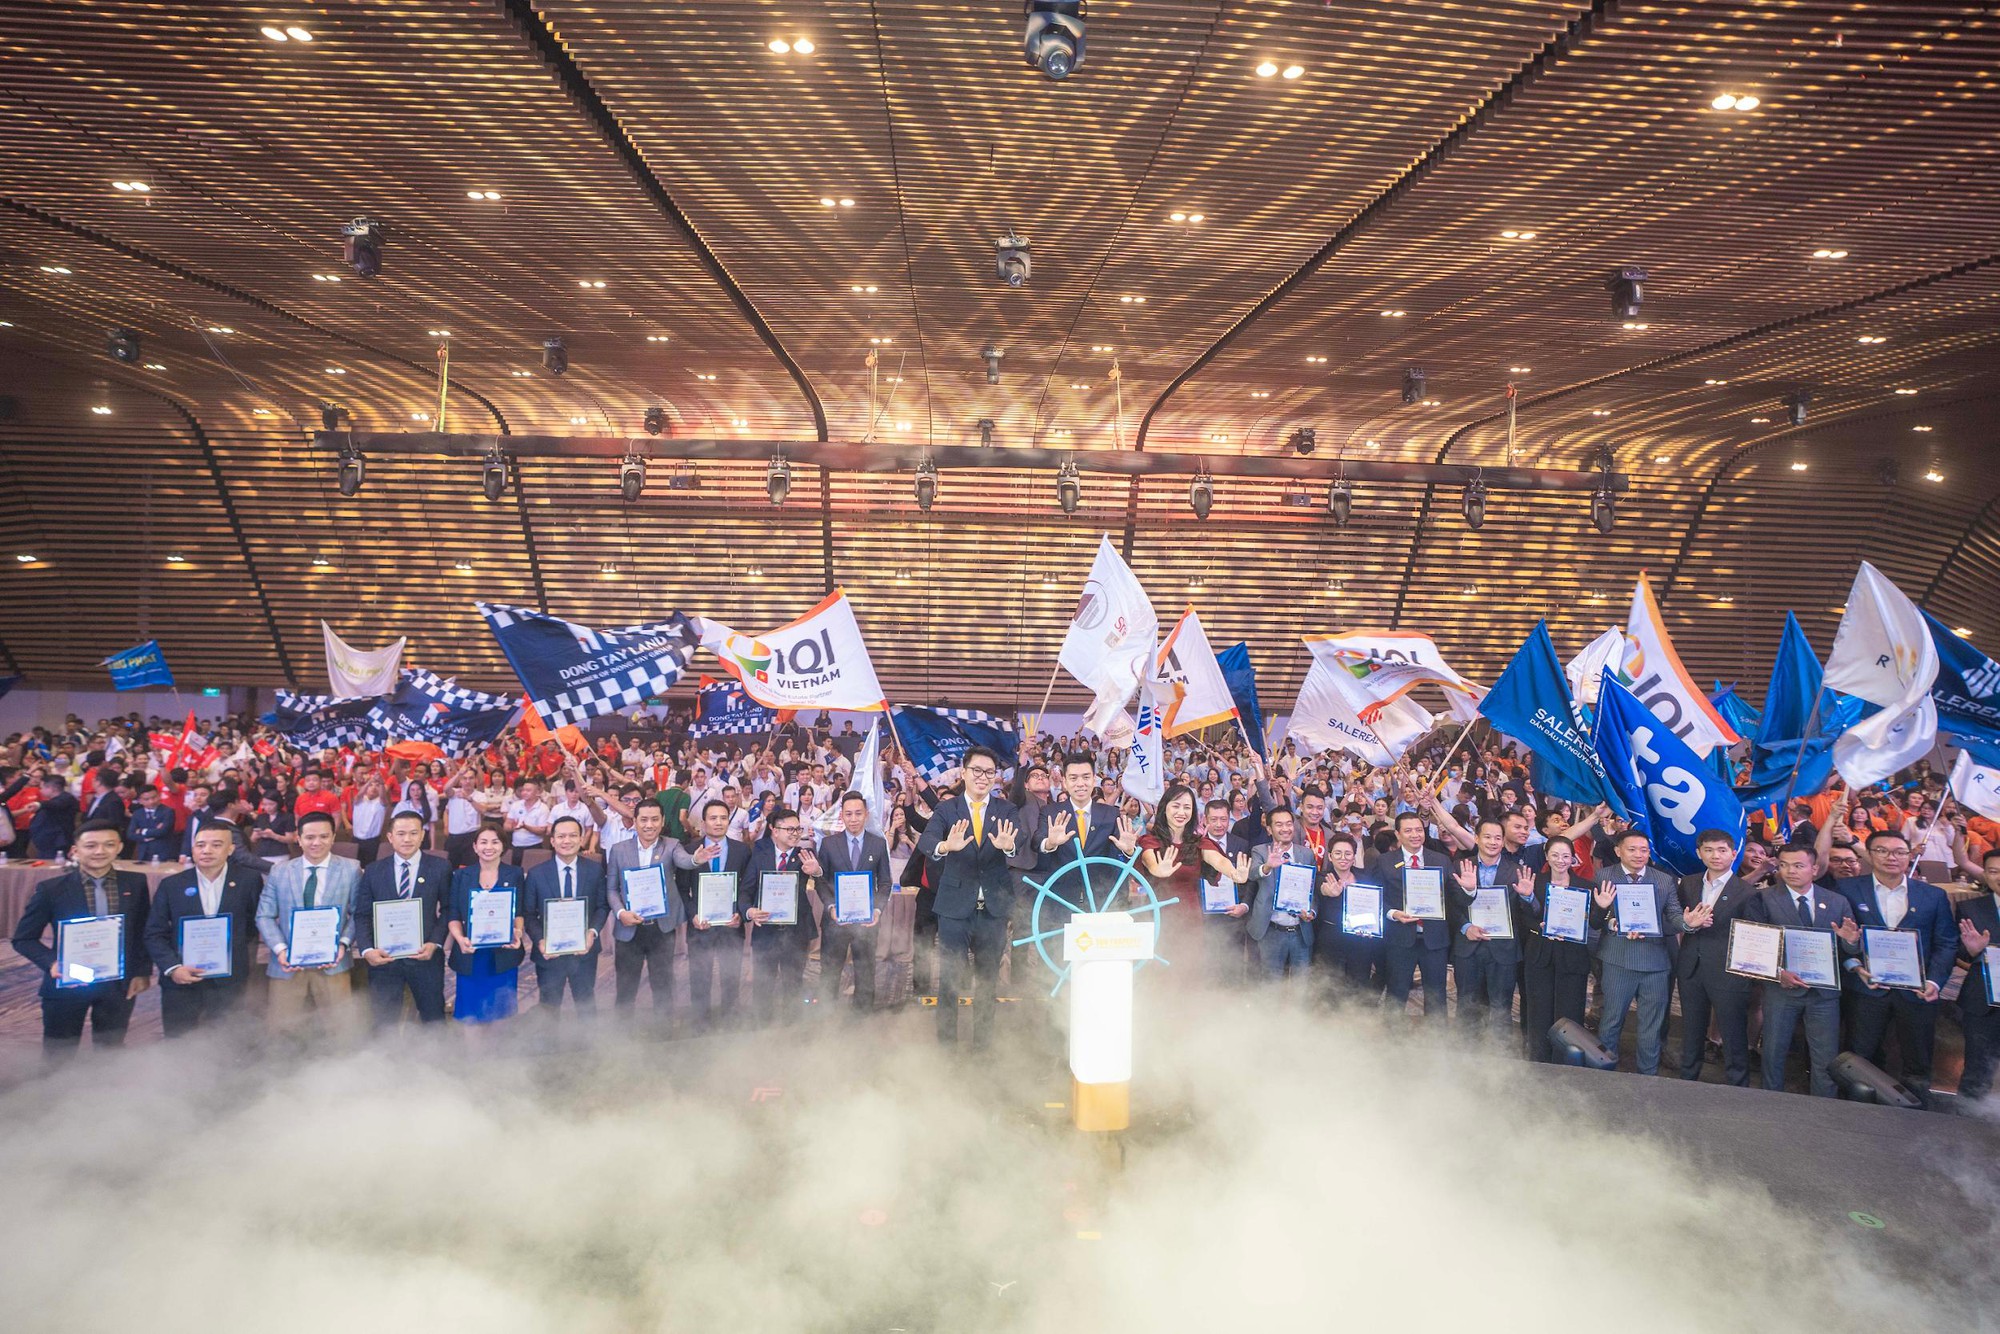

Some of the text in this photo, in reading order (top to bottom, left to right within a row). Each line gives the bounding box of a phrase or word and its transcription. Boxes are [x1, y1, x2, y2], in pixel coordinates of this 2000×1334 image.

[559, 636, 667, 680] DONG TAY LAND
[775, 628, 835, 675] IQI
[572, 674, 599, 686] MEMBER
[598, 669, 609, 678] OF
[609, 661, 635, 674] DONG
[634, 655, 648, 664] TAY
[776, 668, 841, 690] VIETNAM
[1327, 718, 1380, 745] SALEREAL
[1627, 726, 1706, 835] ta
